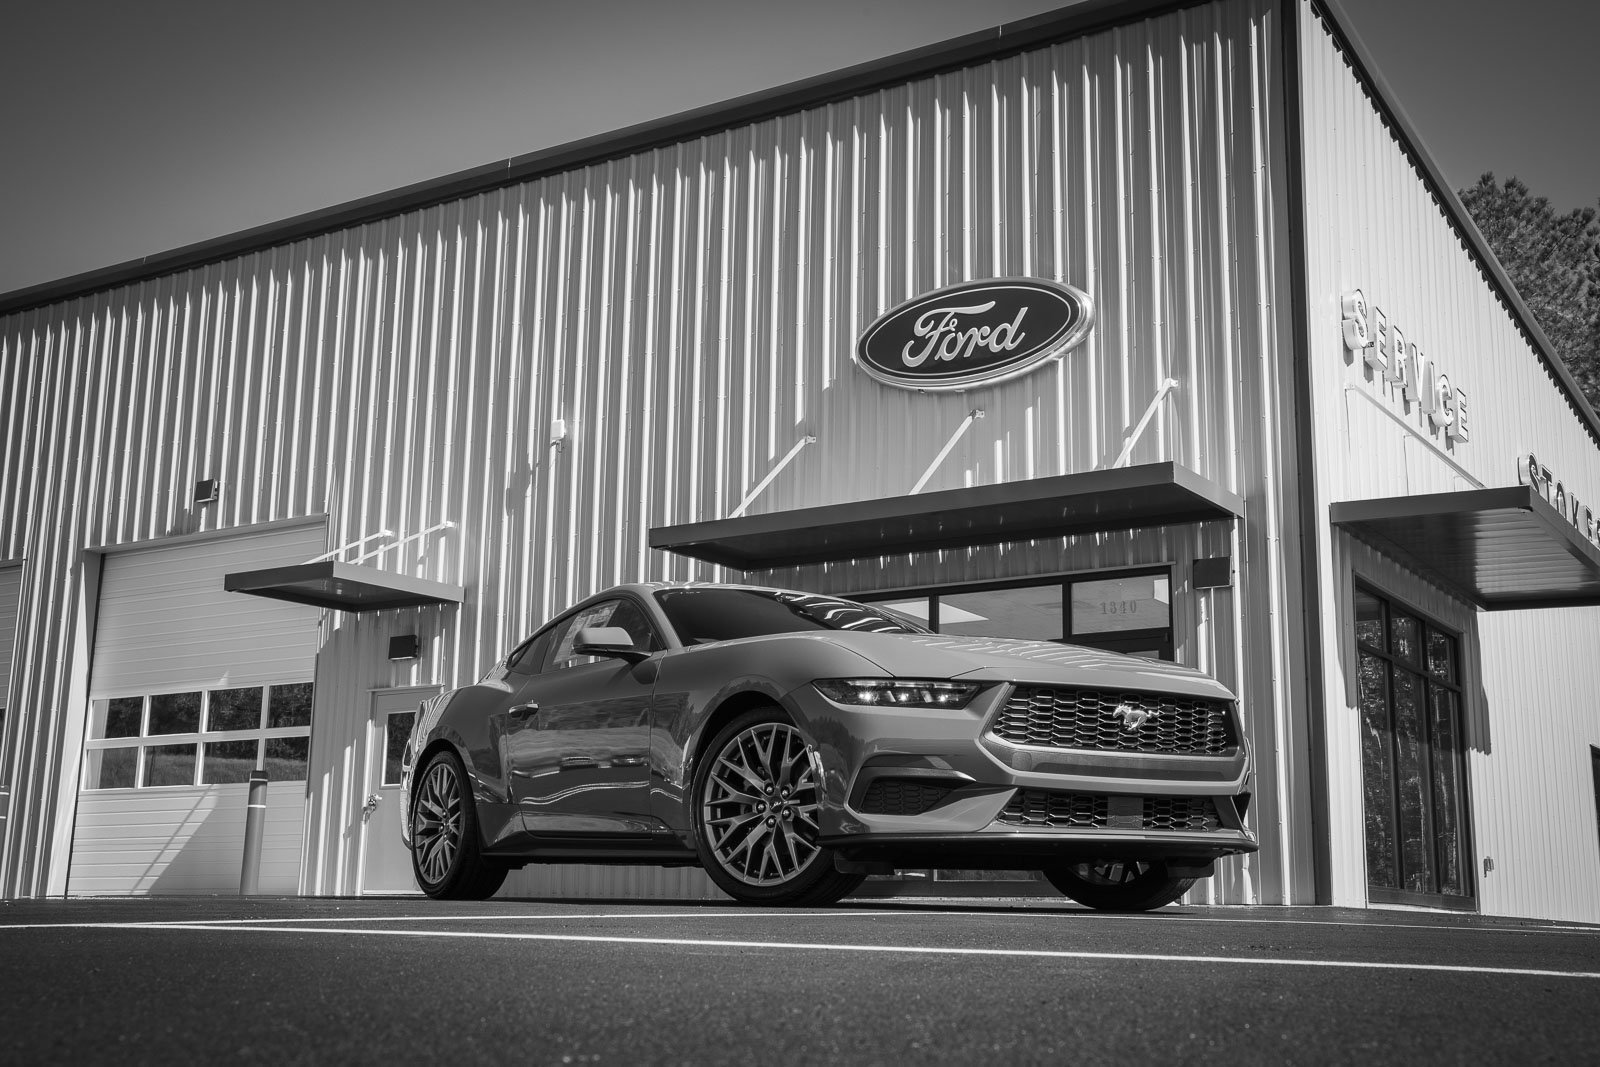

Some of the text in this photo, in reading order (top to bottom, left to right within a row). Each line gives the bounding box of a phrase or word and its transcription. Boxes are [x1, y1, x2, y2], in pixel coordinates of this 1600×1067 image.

[902, 300, 1028, 367] Ford
[1341, 288, 1469, 443] SERVICE
[1518, 452, 1600, 549] STOKE
[1101, 600, 1137, 615] 1340
